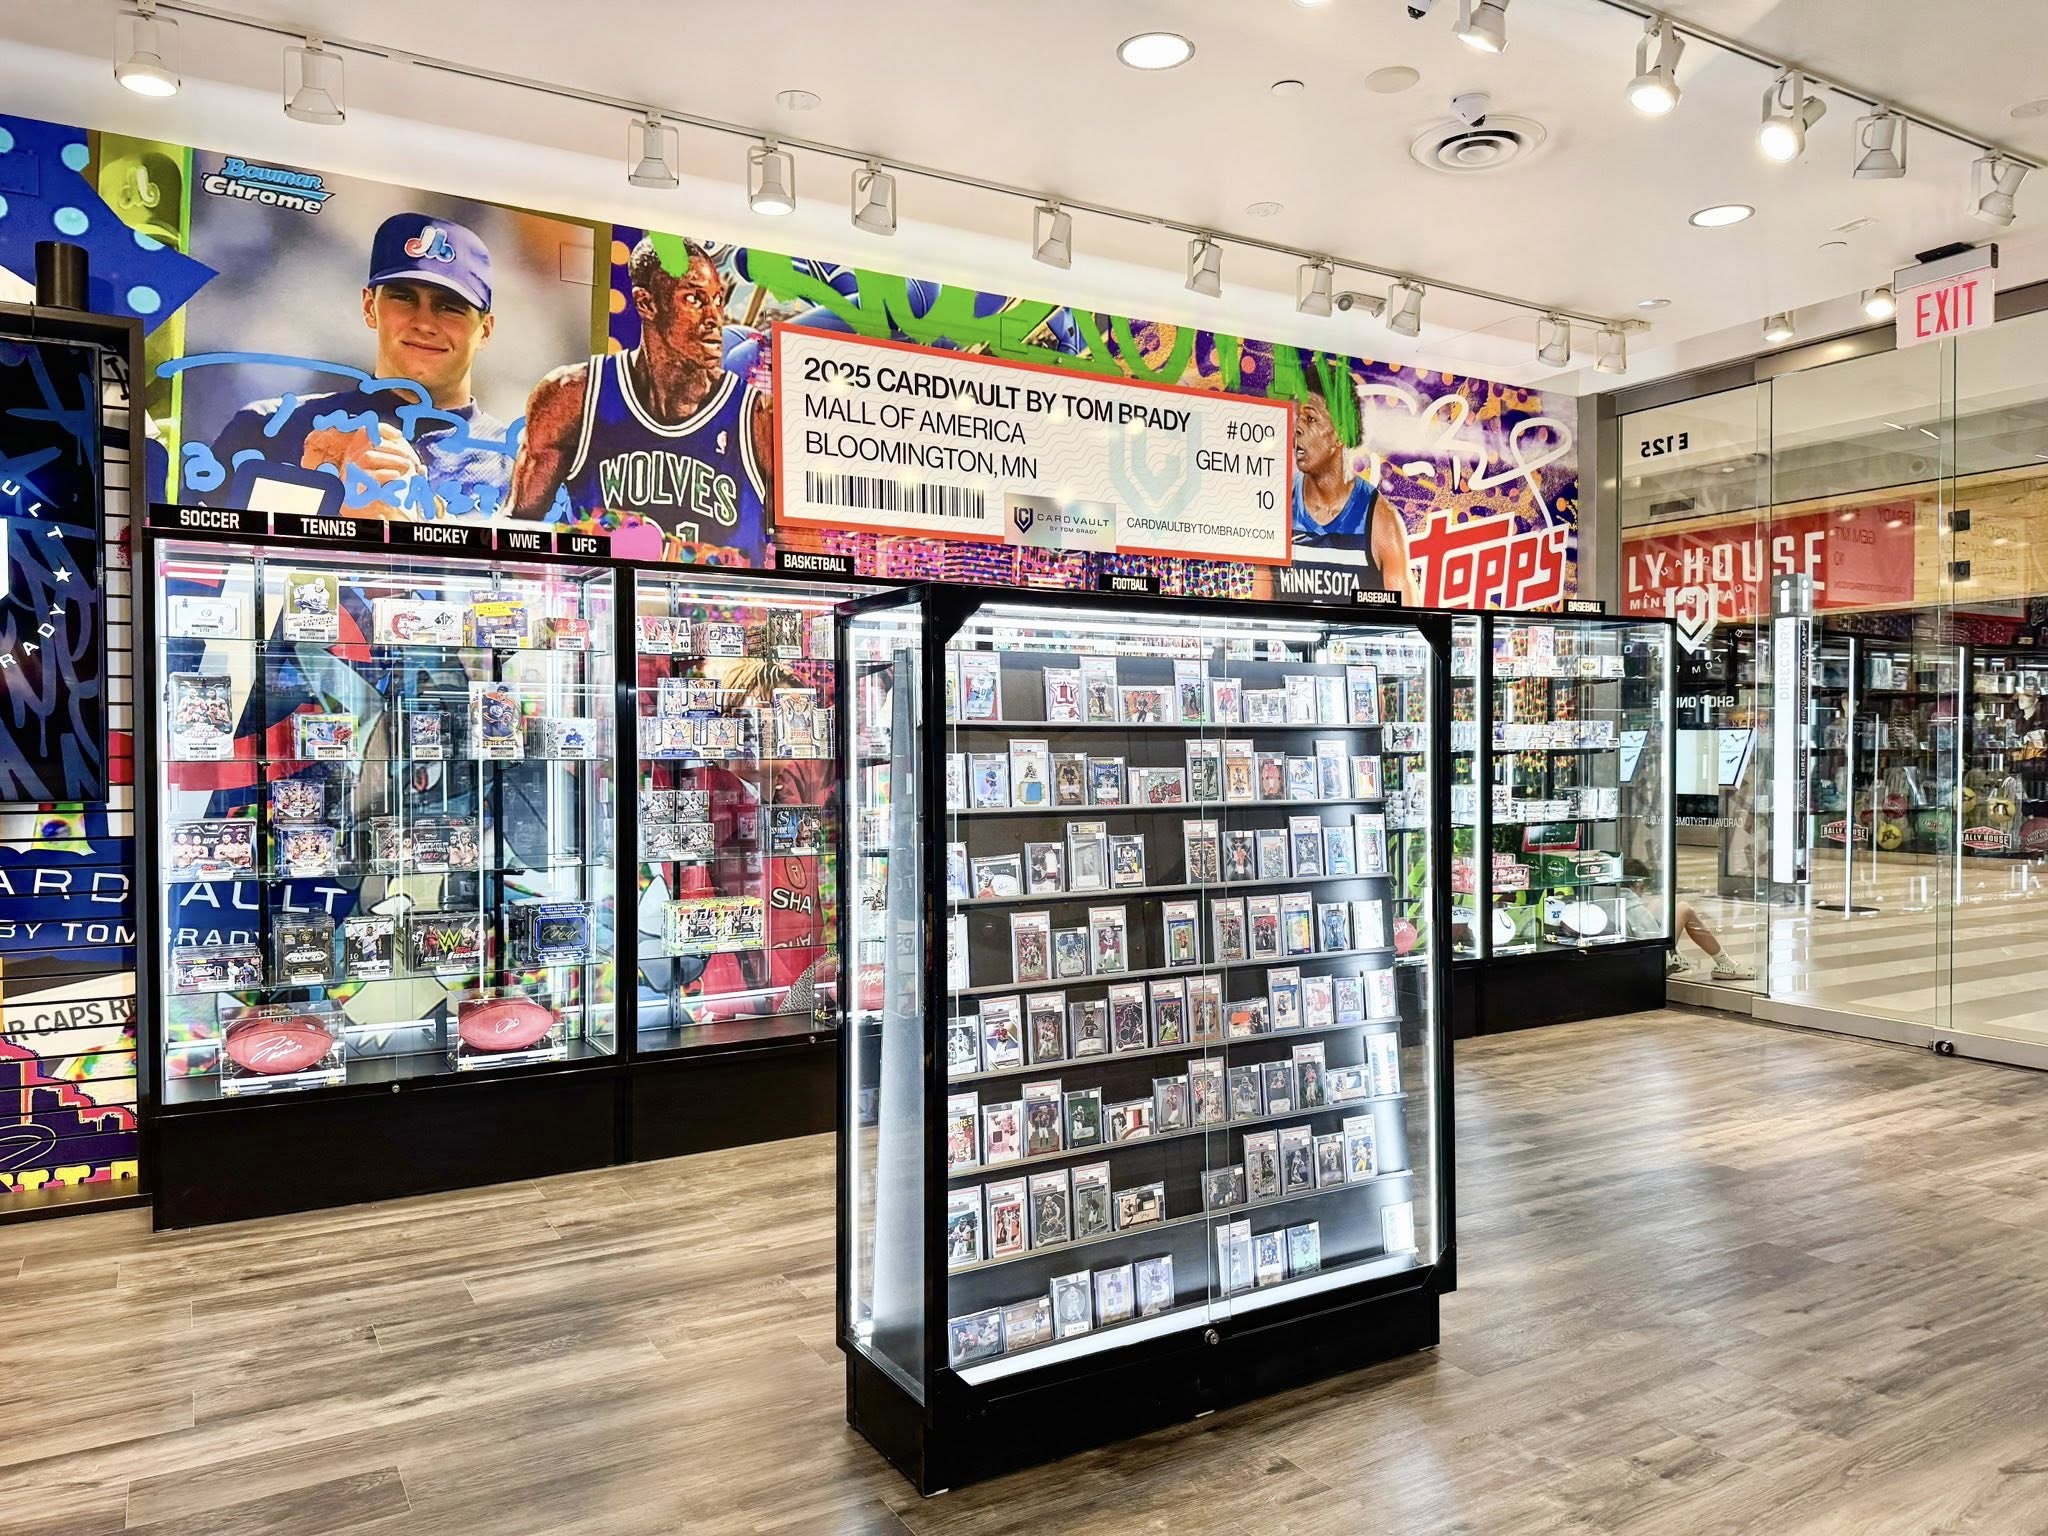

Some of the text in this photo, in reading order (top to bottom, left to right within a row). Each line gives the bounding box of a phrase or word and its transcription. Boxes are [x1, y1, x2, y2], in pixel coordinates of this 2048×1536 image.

[221, 157, 323, 189] Bowman
[202, 173, 322, 213] Chrome
[1916, 281, 1978, 338] EXIT
[804, 357, 1190, 433] 2025 CARDVAULT BY TOM BRADY
[804, 393, 1026, 445] MALL OF AMERICA
[1226, 420, 1274, 443] #009
[1195, 449, 1274, 477] GEM MT
[600, 451, 738, 526] WOLVES
[1254, 491, 1274, 510] 10
[181, 509, 240, 530] SOCCER
[301, 517, 356, 538] TENNIS
[1037, 513, 1109, 528] CARDVAULT
[1126, 516, 1274, 540] CARDVAULTBYTOMBRADY.COM
[413, 525, 469, 545] HOCKEY
[508, 532, 541, 550] WWE
[1077, 528, 1098, 536] BRADY
[571, 536, 598, 554] UFC
[784, 553, 848, 573] BASKETBALL
[1683, 531, 1826, 592] HOUSE
[1112, 576, 1149, 592] FOOTBALL
[1279, 567, 1361, 598] MINNESOTA
[1356, 590, 1398, 604] BASEBALL
[1567, 601, 1602, 613] BASEBALL
[1779, 622, 1792, 700] DIRECTORY
[61, 922, 136, 944] TOM
[34, 1002, 104, 1036] CAPS
